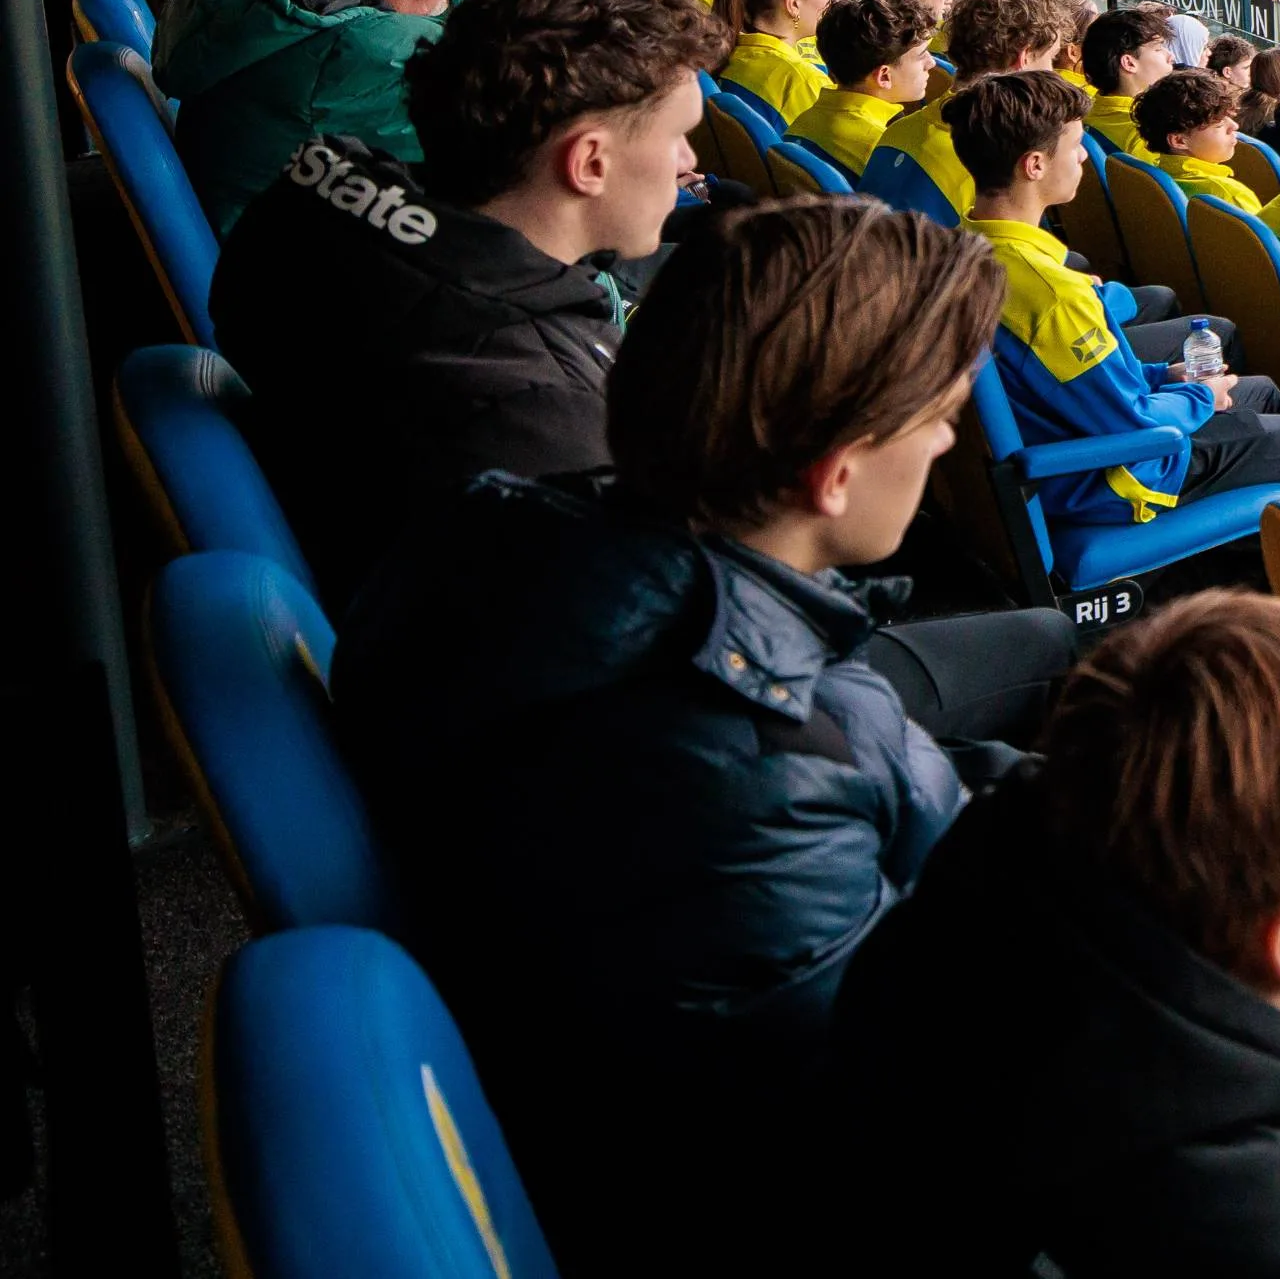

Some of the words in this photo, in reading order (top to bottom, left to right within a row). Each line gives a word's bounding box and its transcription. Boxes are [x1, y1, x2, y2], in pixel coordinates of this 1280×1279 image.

[289, 143, 439, 245] State
[1075, 597, 1110, 625] Rij
[1115, 591, 1132, 615] 3
